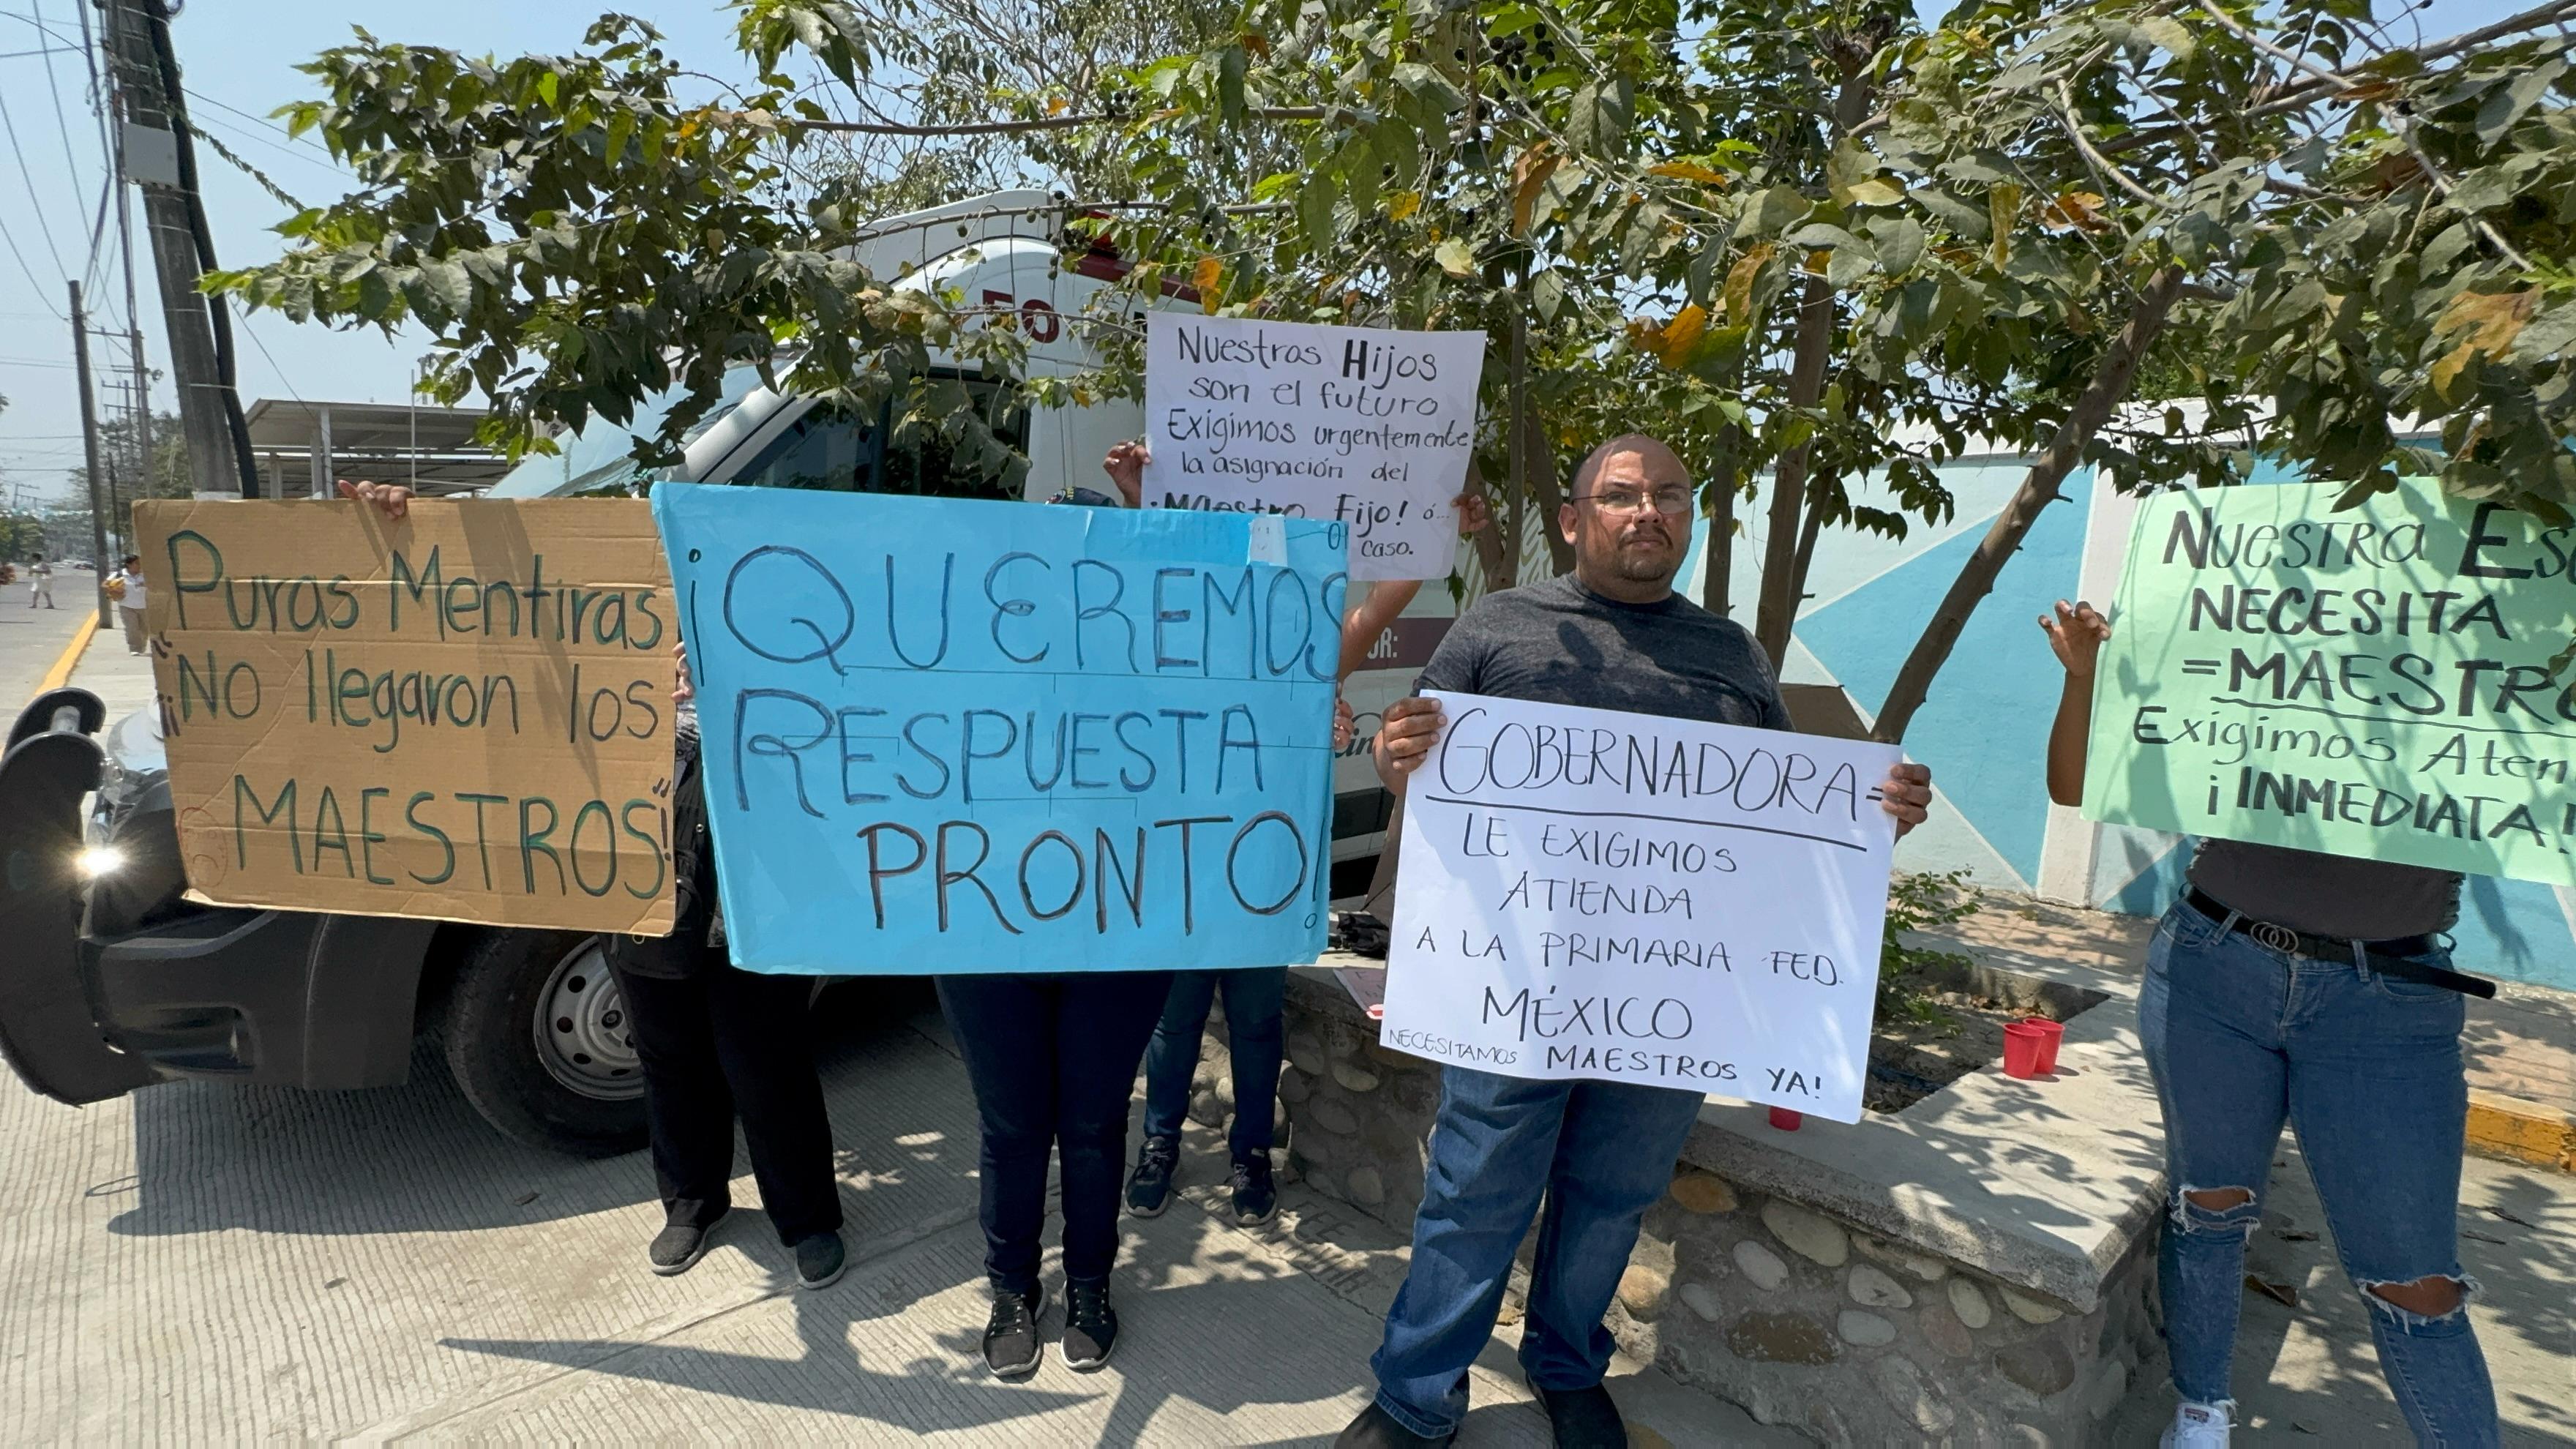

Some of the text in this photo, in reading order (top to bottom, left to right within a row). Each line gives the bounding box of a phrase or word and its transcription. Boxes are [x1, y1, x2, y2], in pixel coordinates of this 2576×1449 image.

[1342, 339, 1437, 390] Hijos
[1188, 376, 1439, 417] son el futuro
[1167, 407, 1469, 456] Exigimos urgentemente
[1182, 451, 1409, 483] la asignación del
[1334, 493, 1408, 538] Fijo!
[1361, 539, 1414, 558] caso.
[168, 530, 663, 651] Puras Mentiras
[2187, 584, 2512, 641] NECESITA
[305, 648, 520, 753] llegaron
[569, 664, 659, 744] los
[733, 688, 1265, 819] RESPUESTA
[2133, 705, 2397, 765] Exigimos
[1463, 812, 1738, 875] LE EXIGIMOS
[856, 810, 1334, 936] PRONTO!
[1498, 870, 1693, 920] ATIENDA
[1416, 926, 1436, 953] A
[1462, 929, 1507, 962] LA
[1539, 931, 1732, 973] PRIMARIA
[1482, 984, 1693, 1042] MÉXICO
[1388, 1027, 1821, 1100] NECESITAMOS MAESTROS YA!
